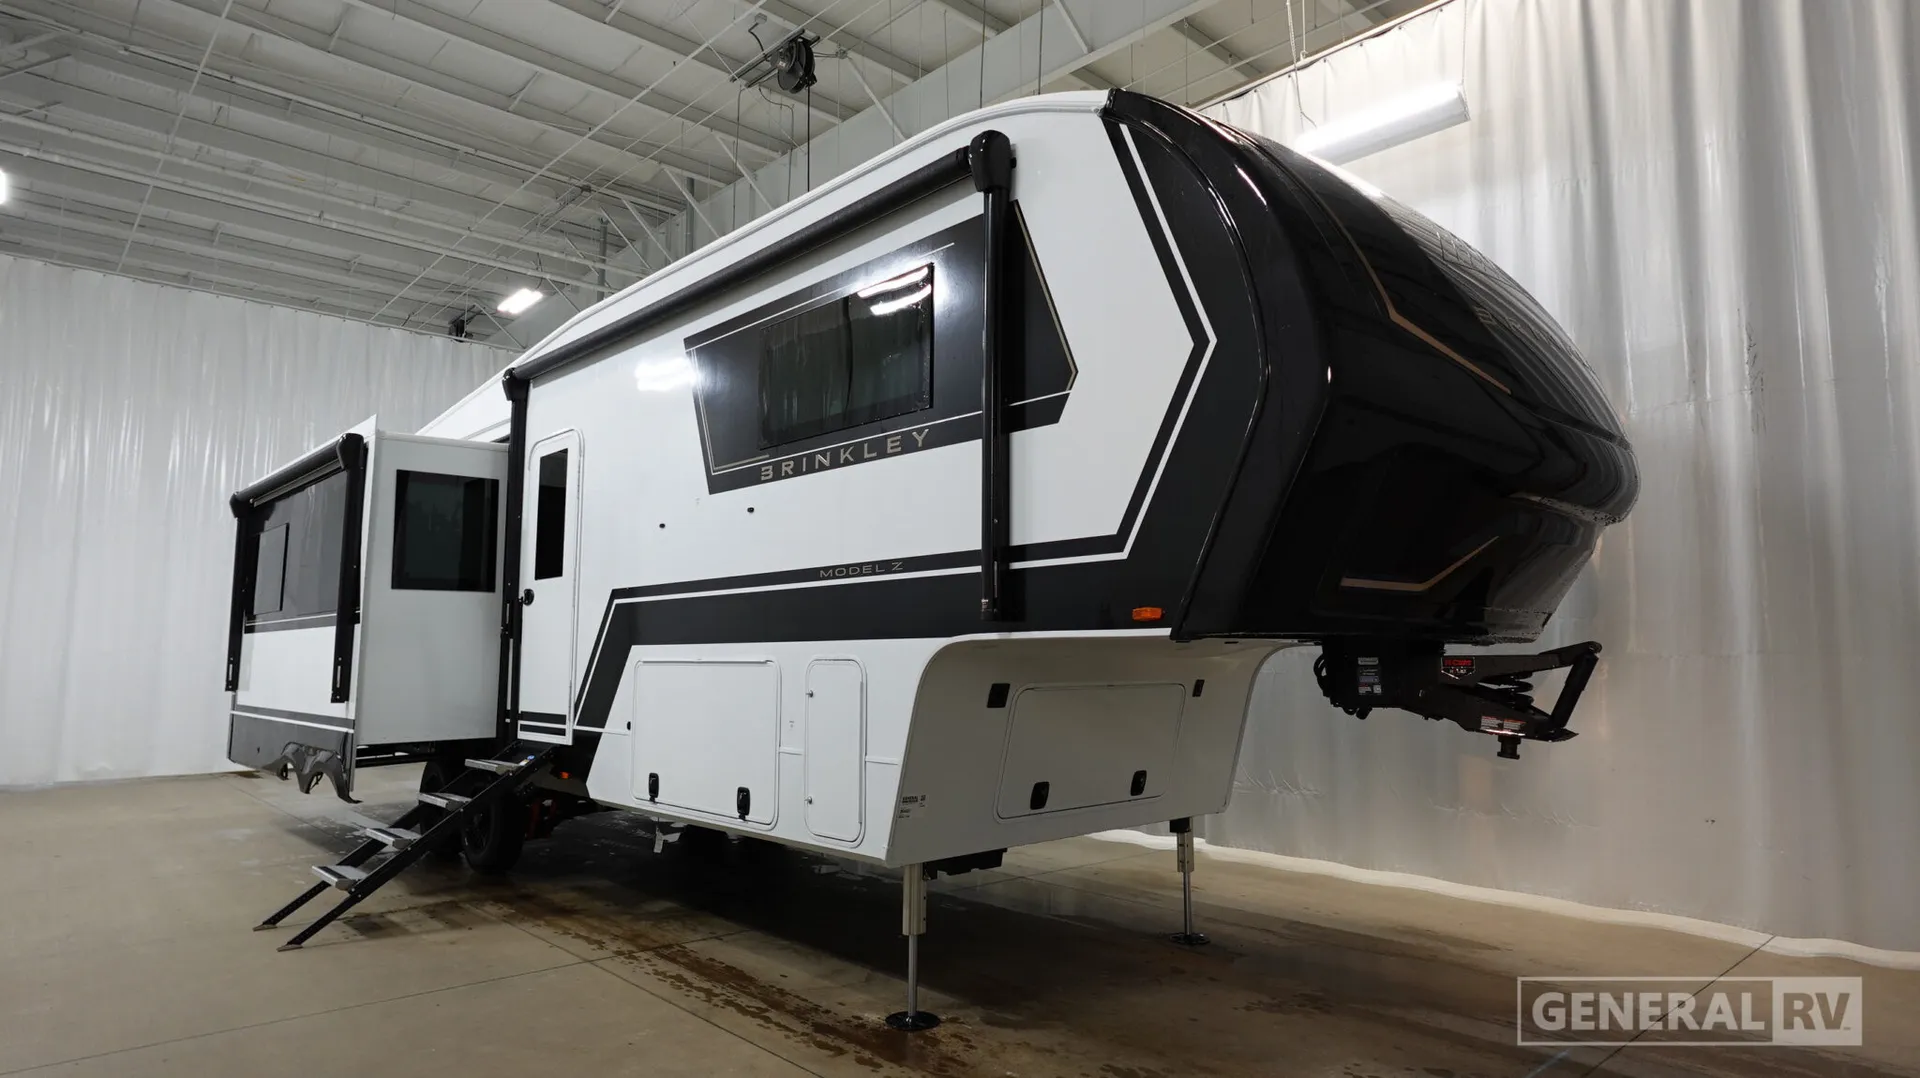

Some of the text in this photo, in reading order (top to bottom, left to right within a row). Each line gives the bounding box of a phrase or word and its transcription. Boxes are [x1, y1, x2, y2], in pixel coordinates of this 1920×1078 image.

[760, 428, 929, 481] BRINKLEY
[820, 561, 904, 578] MODEL Z
